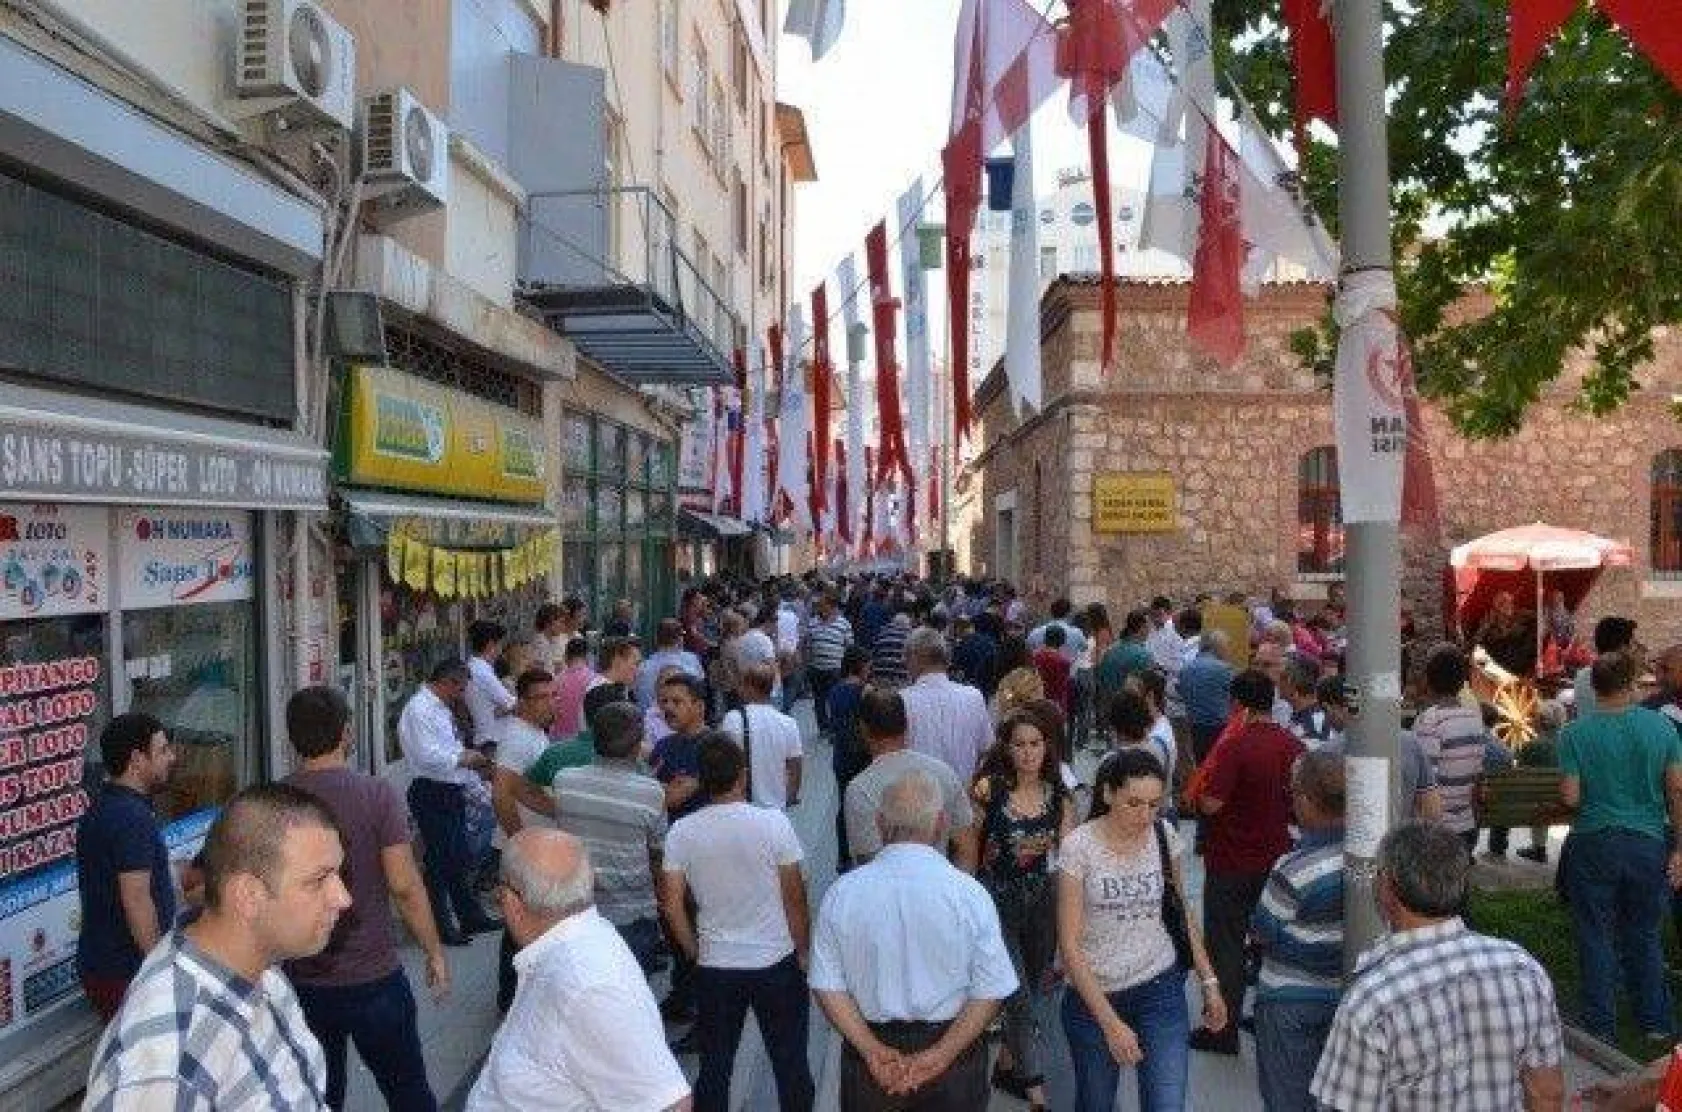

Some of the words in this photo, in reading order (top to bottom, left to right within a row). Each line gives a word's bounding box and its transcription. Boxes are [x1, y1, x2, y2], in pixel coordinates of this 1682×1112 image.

[70, 441, 122, 487] TOPU
[199, 456, 238, 494] LOTO
[167, 519, 233, 540] NUMARA
[37, 689, 96, 725] LOTO
[29, 722, 87, 761] LOTO
[22, 756, 84, 798] TOPU
[1101, 869, 1162, 900] BEST
